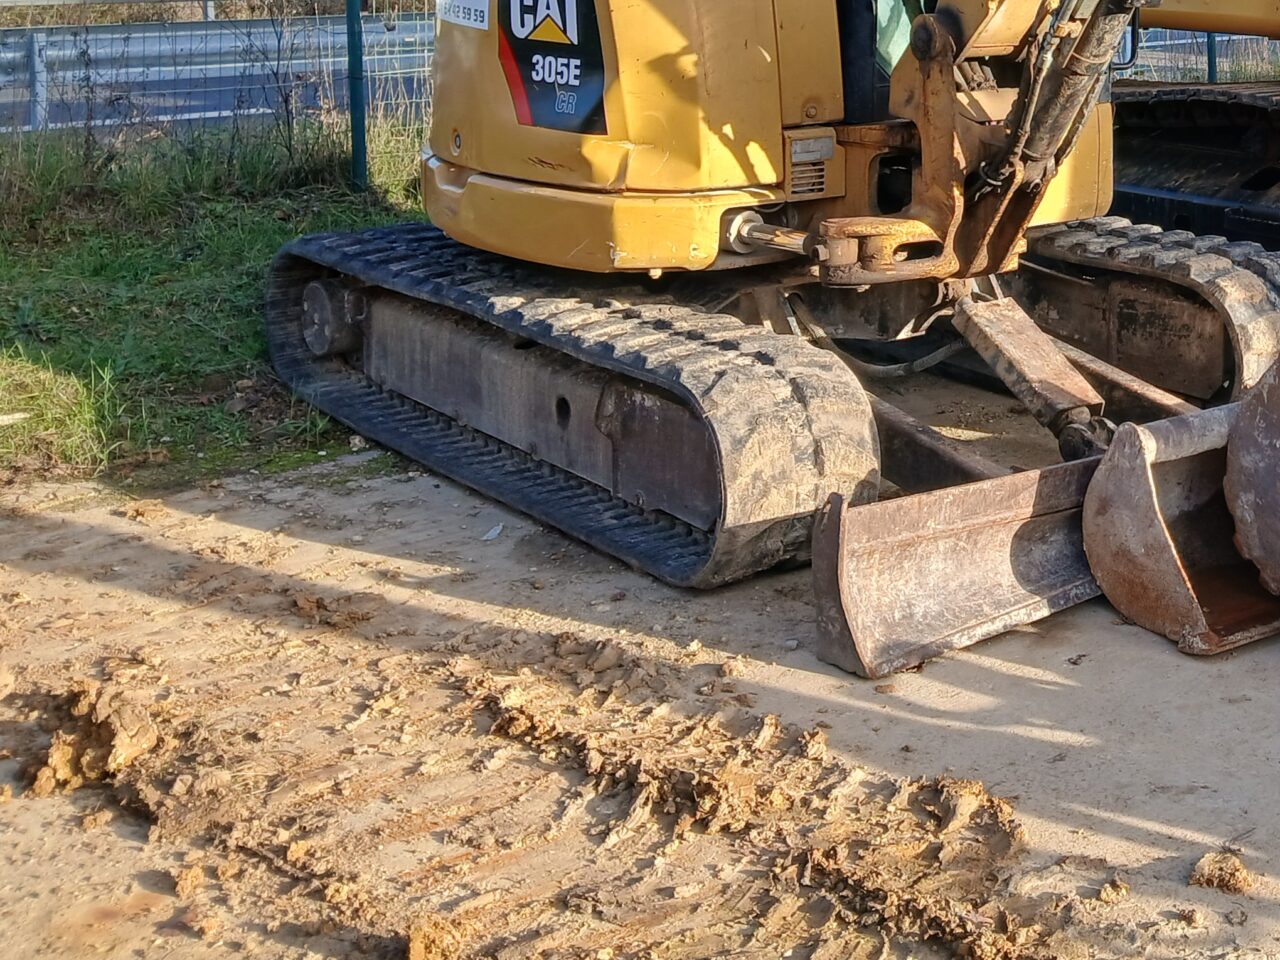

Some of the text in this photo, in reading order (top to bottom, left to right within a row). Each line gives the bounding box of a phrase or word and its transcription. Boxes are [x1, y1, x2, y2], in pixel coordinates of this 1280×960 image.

[462, 6, 472, 21] 59
[473, 8, 485, 24] 59
[531, 54, 581, 86] 305E
[555, 91, 577, 114] CR
